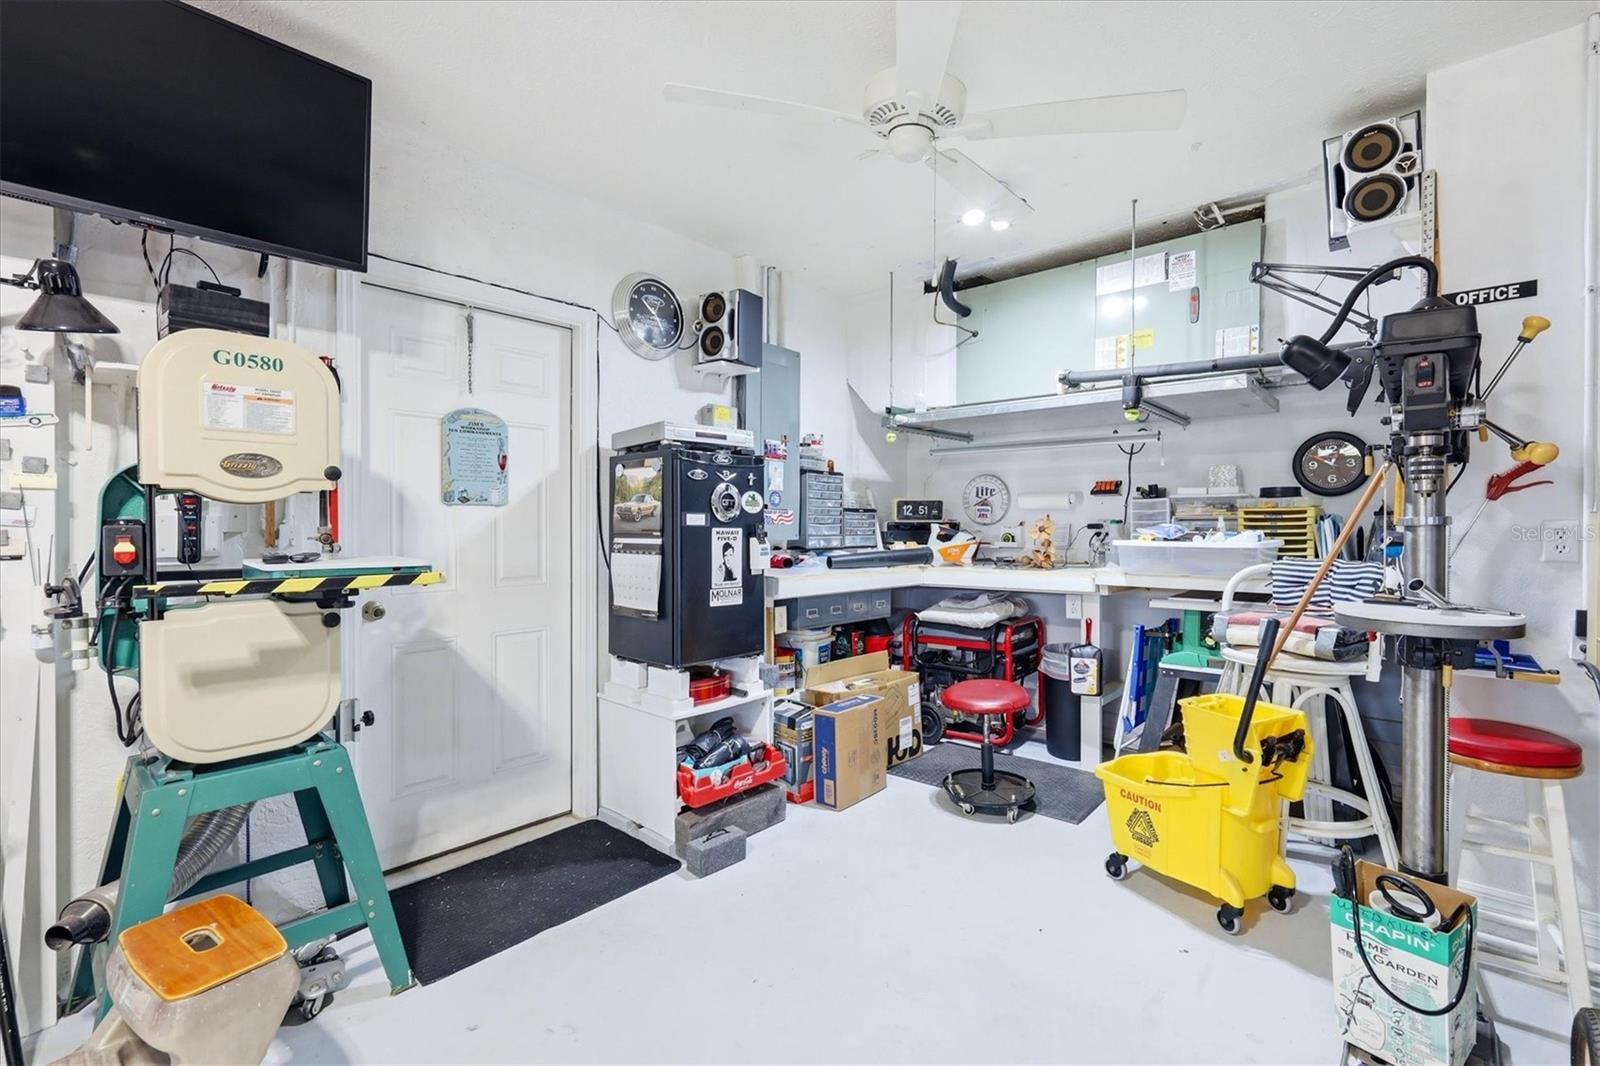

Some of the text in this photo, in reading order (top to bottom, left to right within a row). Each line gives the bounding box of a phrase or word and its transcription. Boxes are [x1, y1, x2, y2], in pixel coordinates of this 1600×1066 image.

[1455, 284, 1520, 306] OFFICE
[213, 349, 283, 372] G0580
[1308, 461, 1318, 470] 9
[1345, 458, 1356, 467] 3
[1327, 474, 1337, 483] 6
[975, 486, 996, 499] Lite
[902, 505, 928, 516] 12 51
[1120, 788, 1162, 813] CAUTION
[1373, 954, 1438, 986] GARDEN
